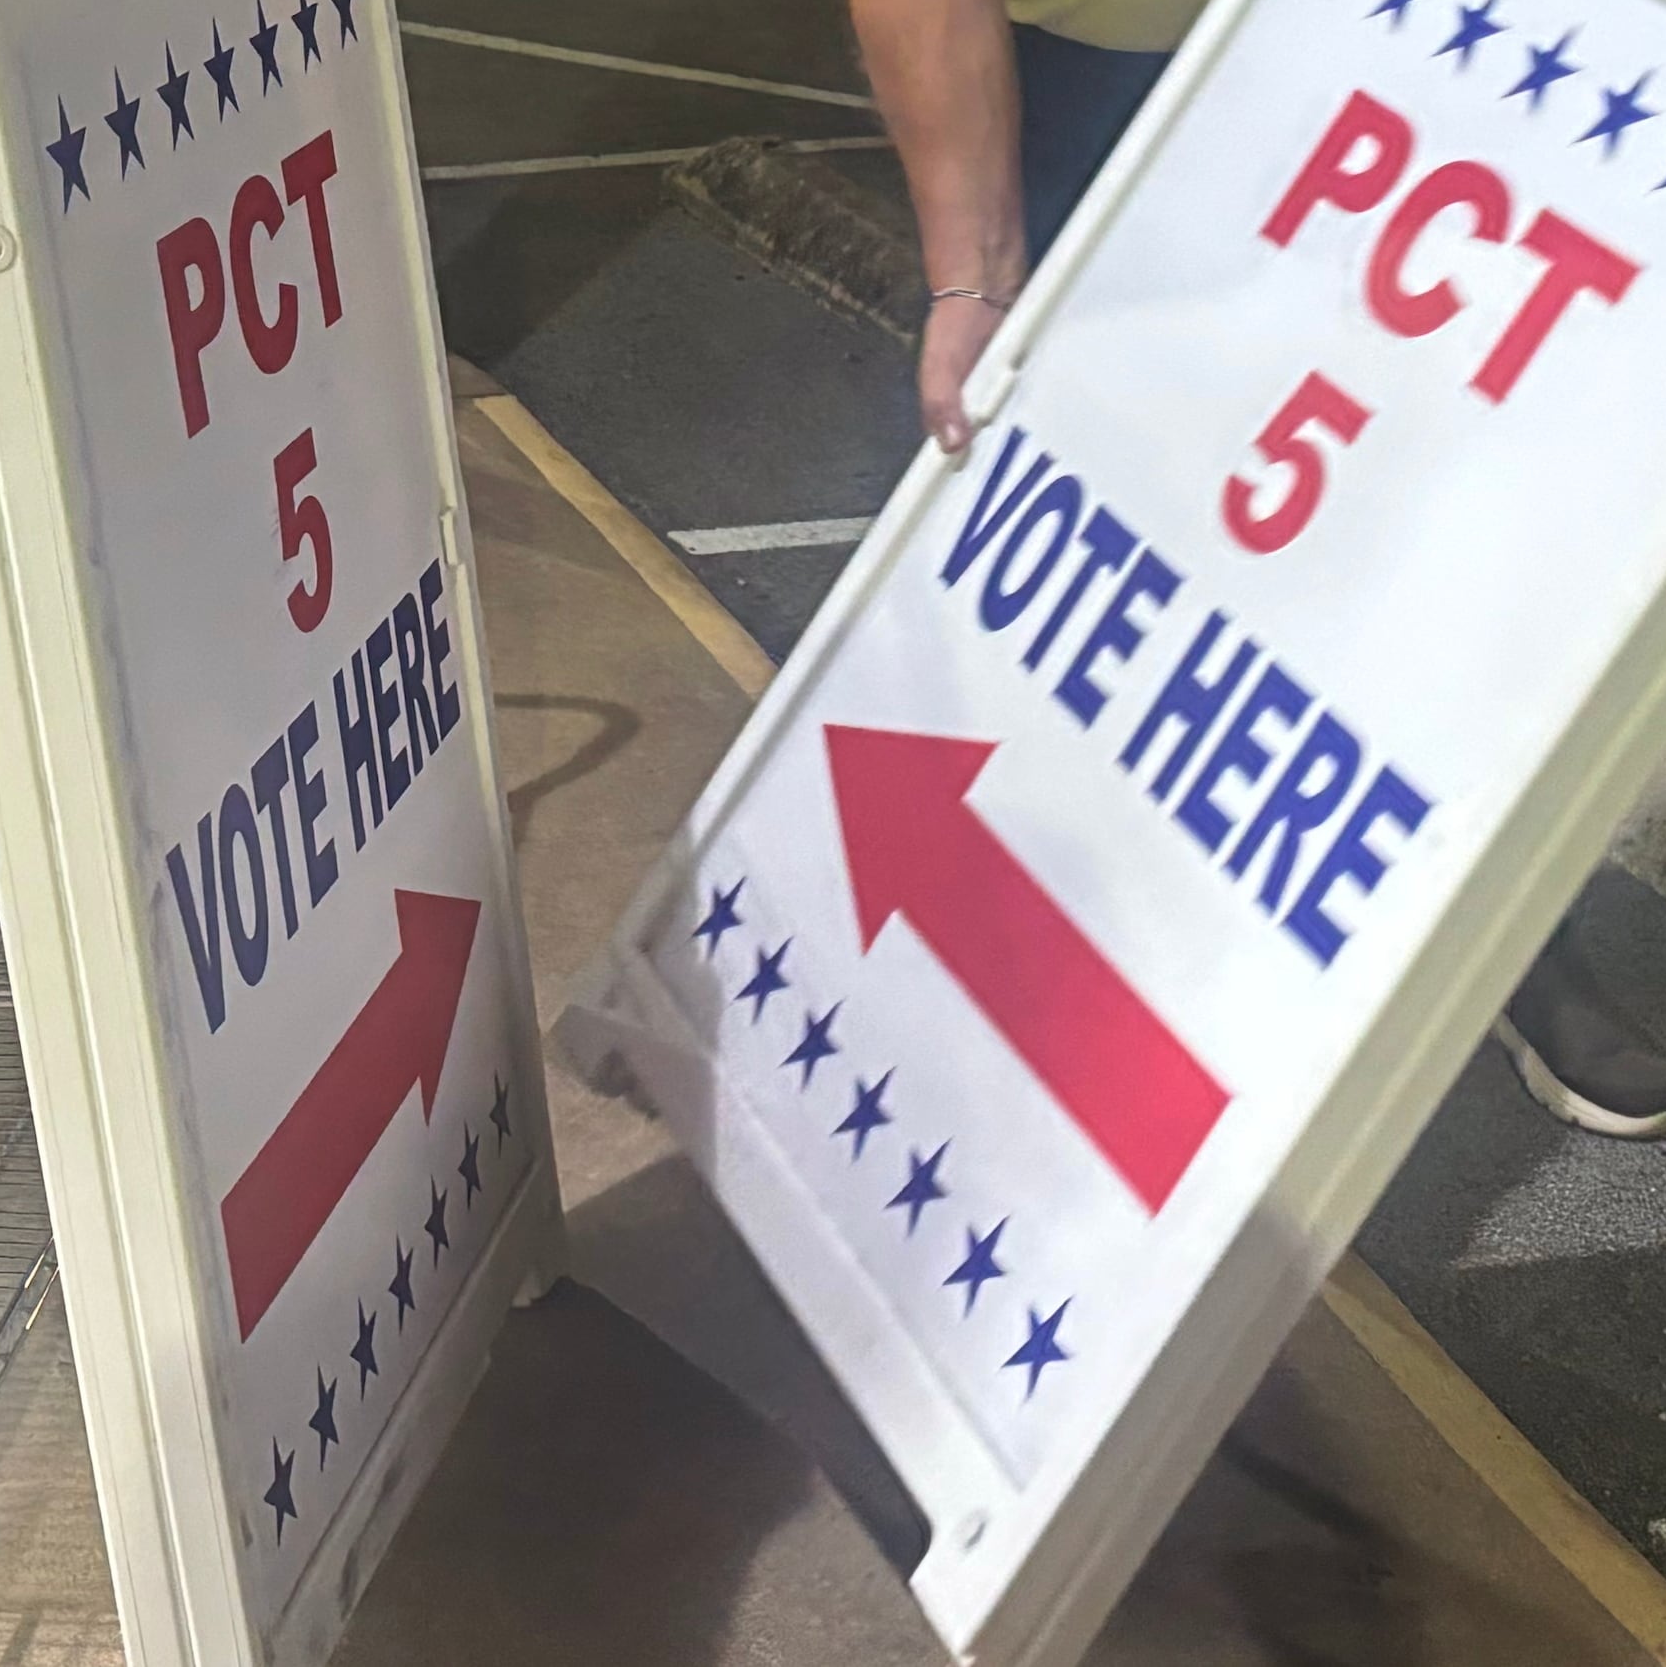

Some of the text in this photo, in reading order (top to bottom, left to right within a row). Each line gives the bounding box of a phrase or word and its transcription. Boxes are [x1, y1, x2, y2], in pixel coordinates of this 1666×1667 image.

[156, 128, 343, 439] PCT
[1258, 88, 1647, 406] PCT
[273, 426, 334, 634] 5
[1219, 367, 1377, 556] 5
[165, 557, 461, 1035] VOTE HERE
[937, 424, 1438, 973] VOTE HERE
